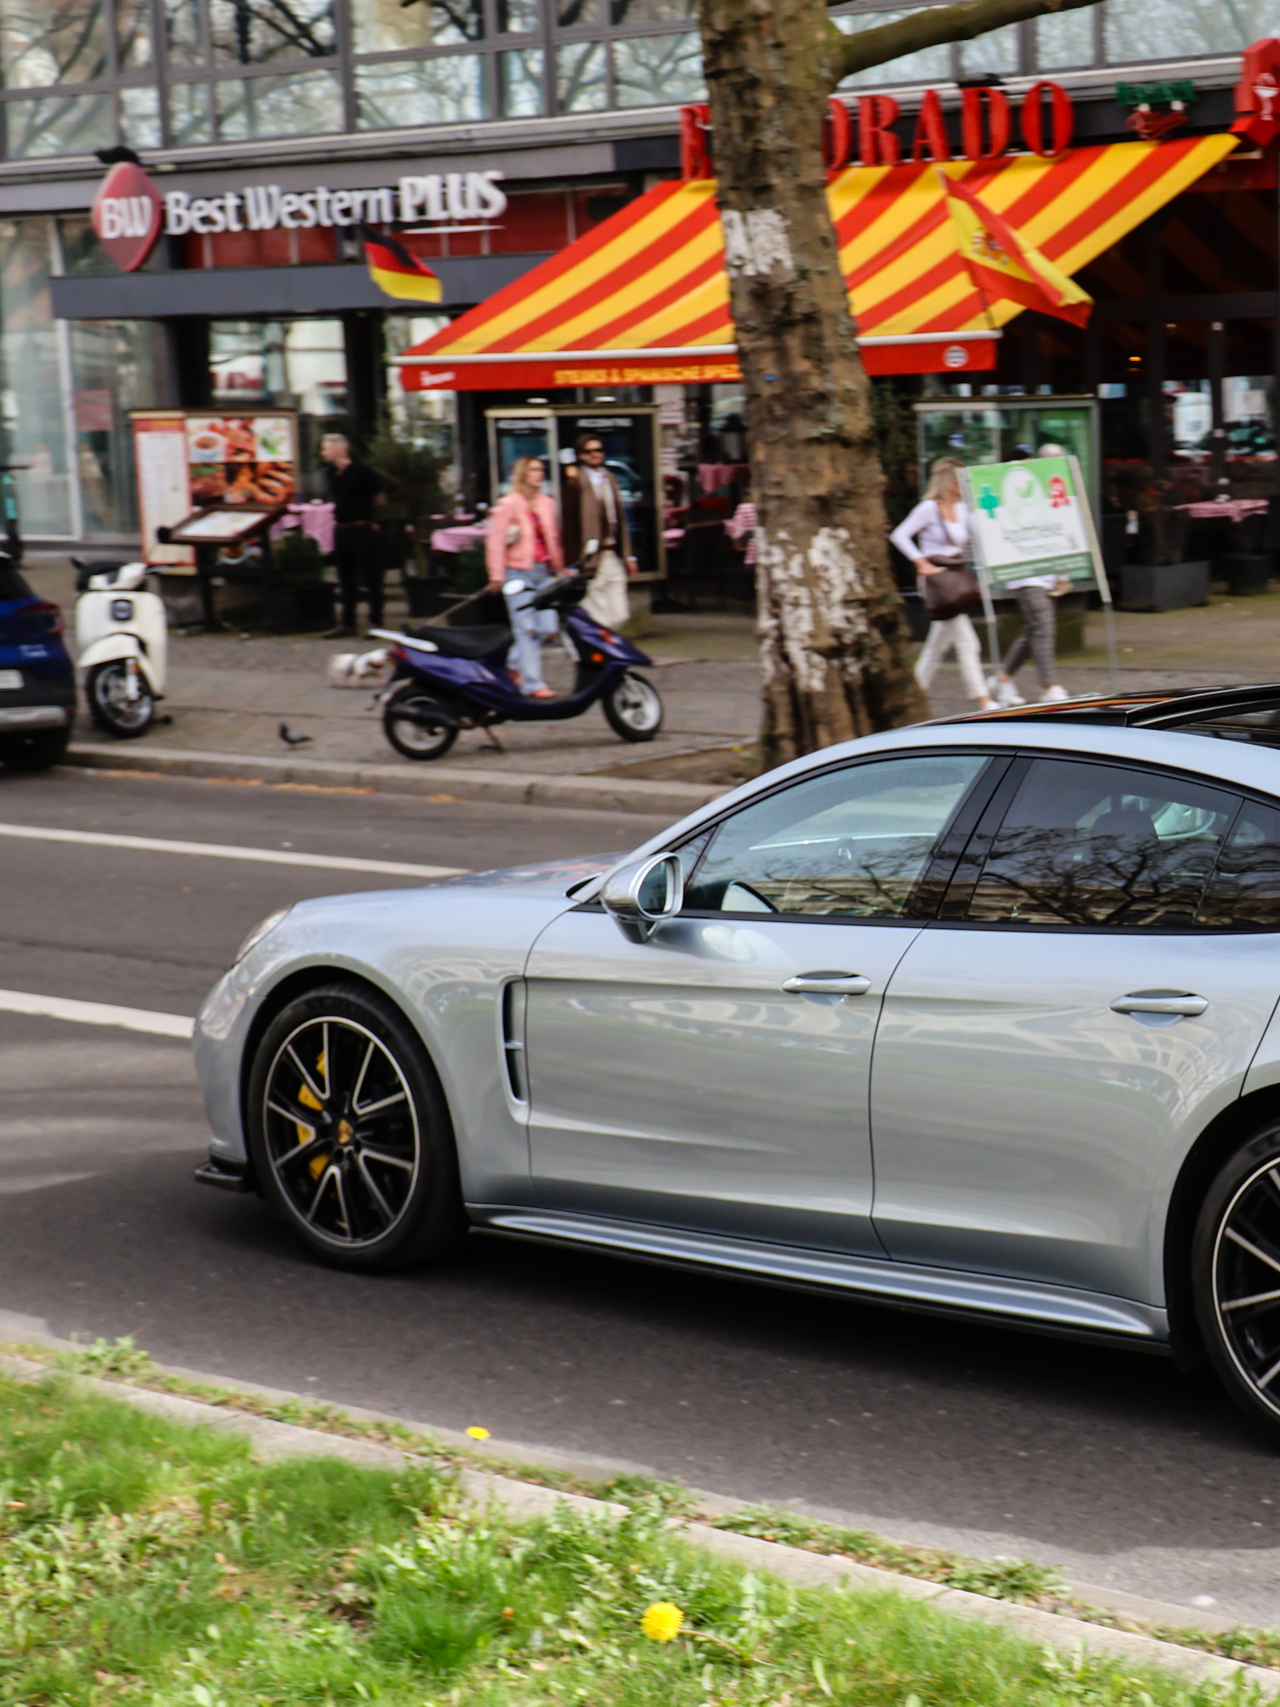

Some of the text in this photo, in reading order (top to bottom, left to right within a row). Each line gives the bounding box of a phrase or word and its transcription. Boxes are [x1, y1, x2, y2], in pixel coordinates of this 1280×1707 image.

[101, 195, 152, 240] BW
[164, 170, 508, 236] Best Western PLUS
